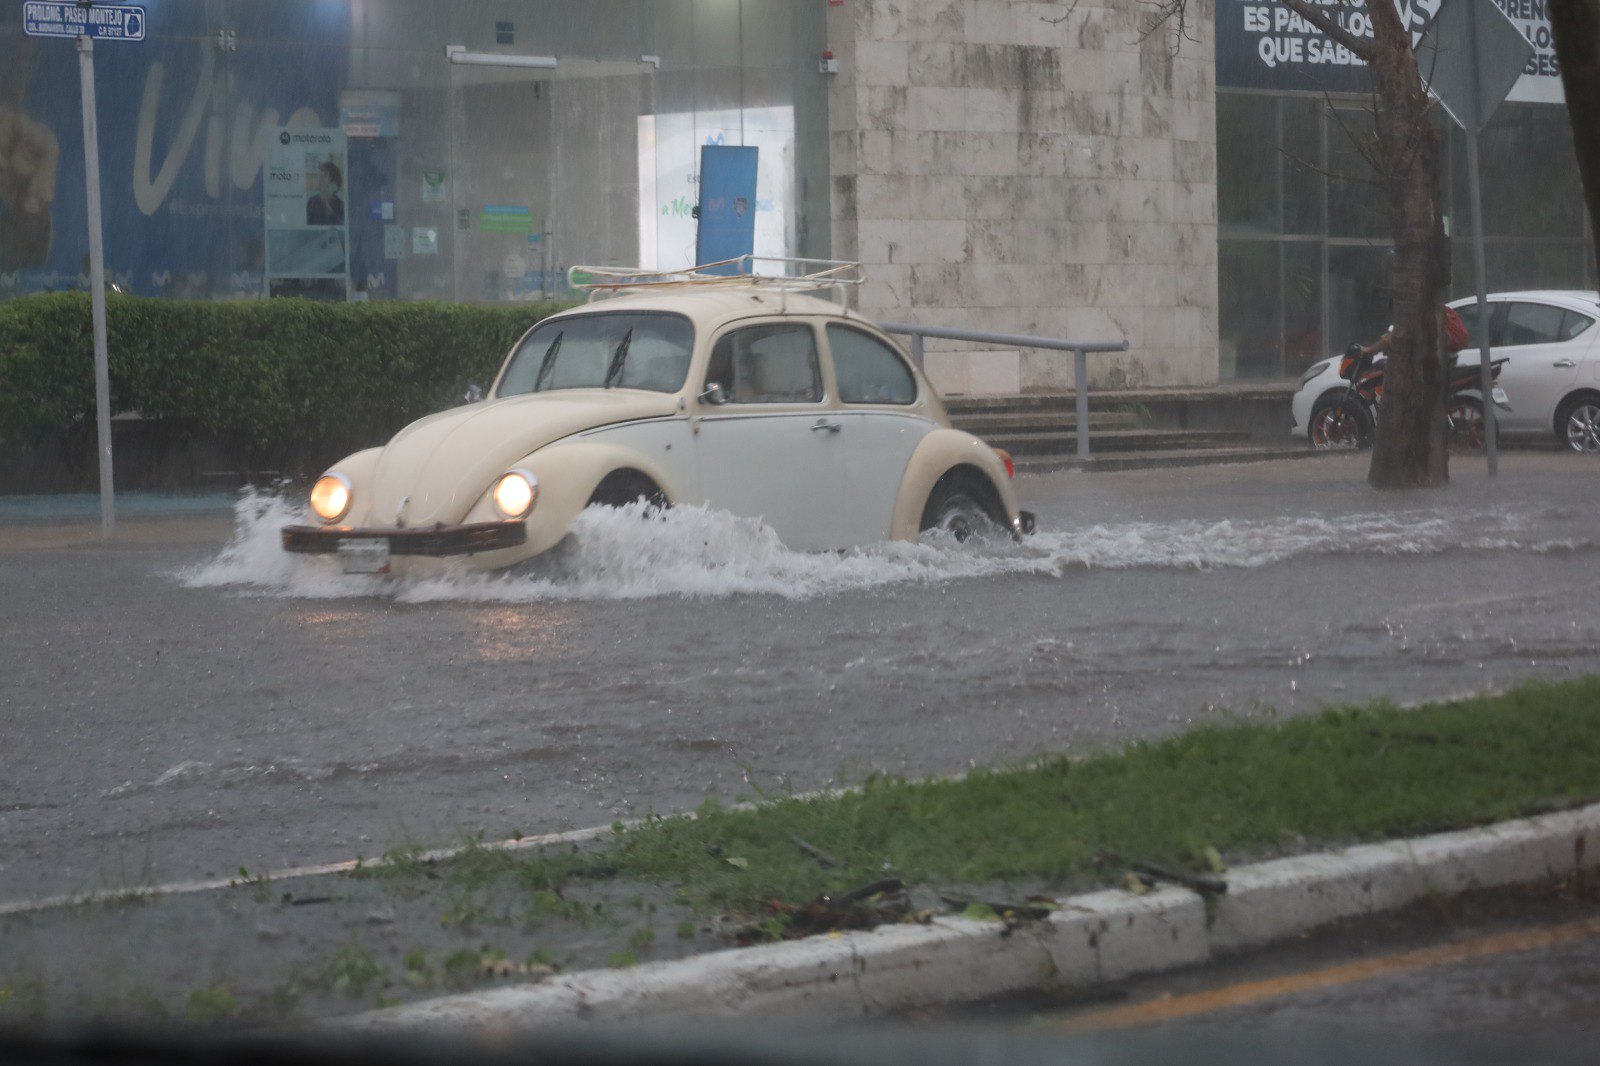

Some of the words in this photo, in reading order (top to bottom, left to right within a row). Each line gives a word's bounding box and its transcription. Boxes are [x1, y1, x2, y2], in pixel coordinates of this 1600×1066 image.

[27, 5, 63, 22] PROLONG.
[64, 8, 87, 24] PASEO
[88, 9, 123, 26] MONTEJO
[1243, 6, 1270, 32] ES
[1258, 36, 1303, 68] QUE
[292, 133, 332, 144] motorola
[270, 171, 291, 181] moto
